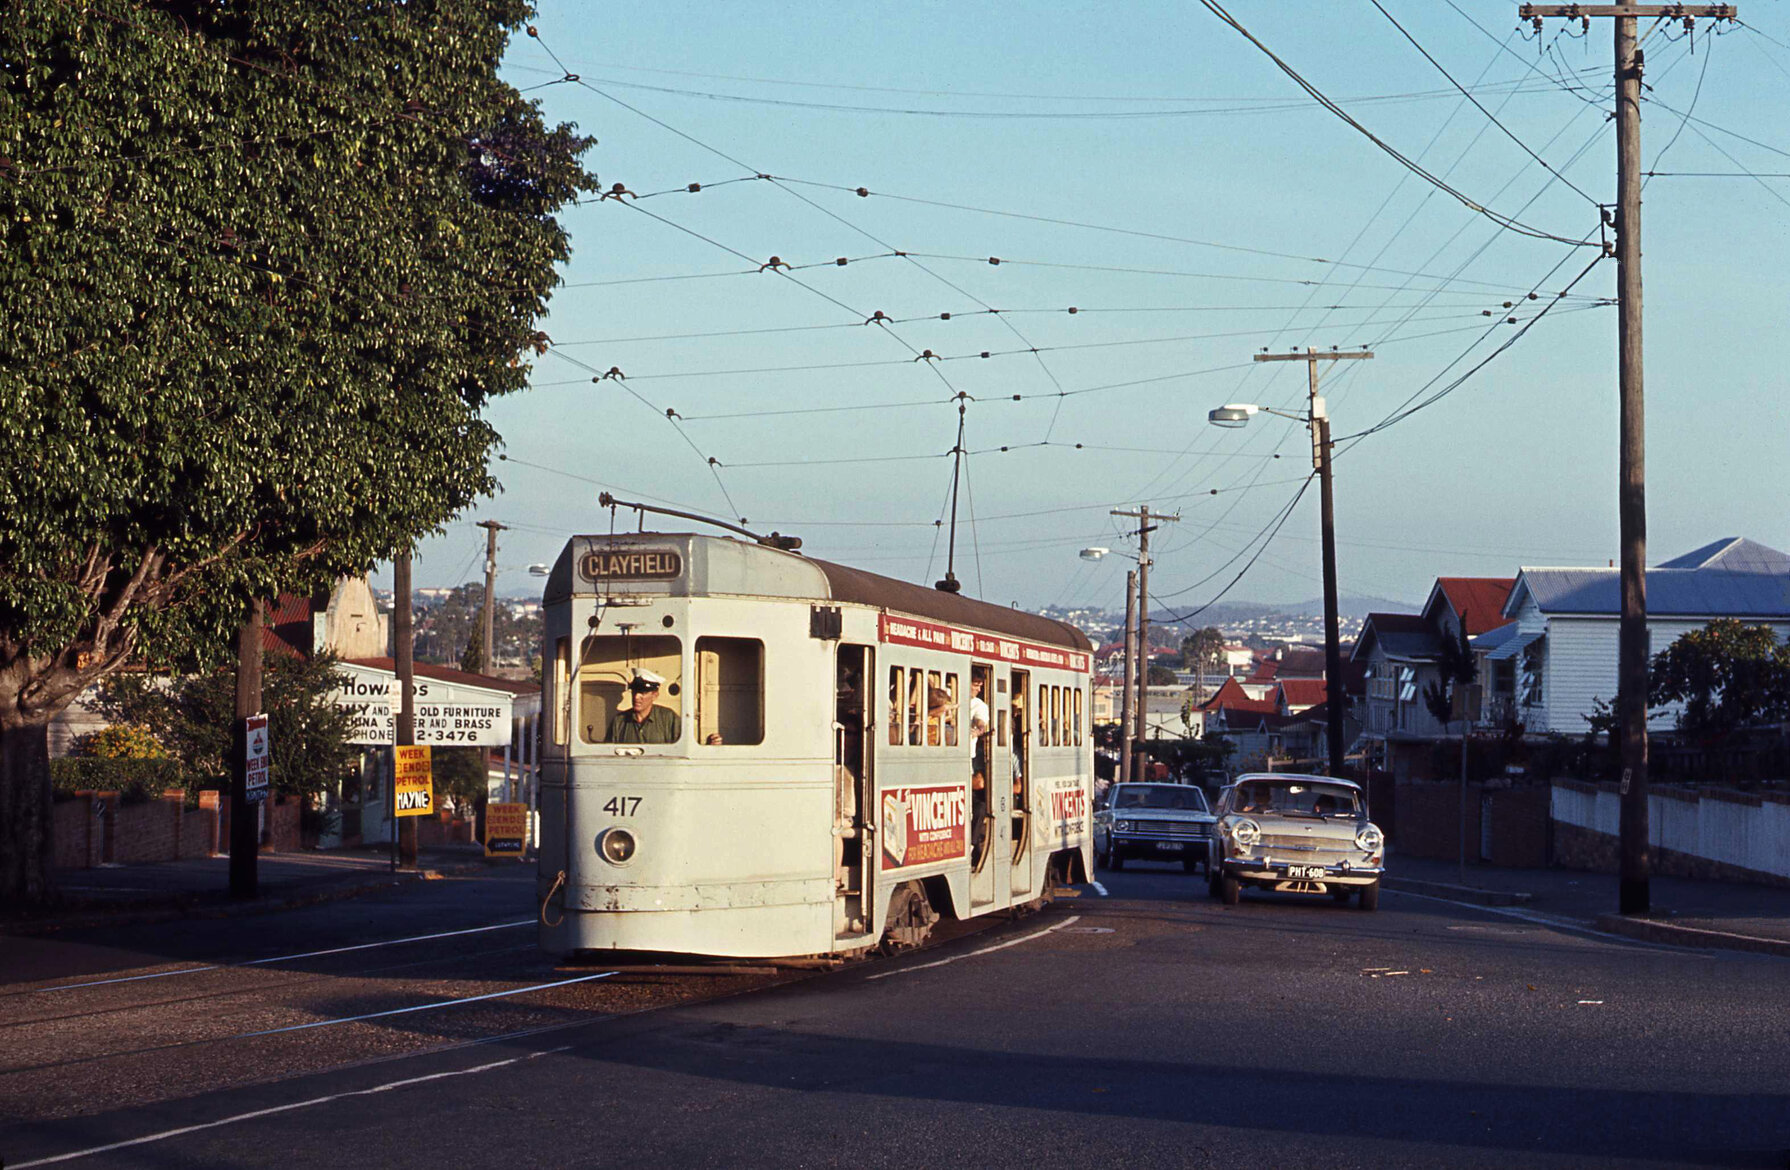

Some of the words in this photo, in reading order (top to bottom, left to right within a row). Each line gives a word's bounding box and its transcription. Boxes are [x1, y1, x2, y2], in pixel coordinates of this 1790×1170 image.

[588, 554, 675, 576] CLAYFIELD
[372, 706, 389, 716] AND
[420, 707, 439, 717] OLD
[443, 707, 501, 718] FURNITURE
[429, 718, 447, 728] AND
[454, 719, 492, 729] BRASS
[399, 748, 425, 760] WEEK
[248, 770, 267, 787] PETROL
[396, 775, 430, 786] PETROL
[397, 790, 429, 810] MAYNE
[603, 796, 643, 817] 417
[493, 805, 520, 815] WEEK
[911, 787, 965, 832] VINCENT'S
